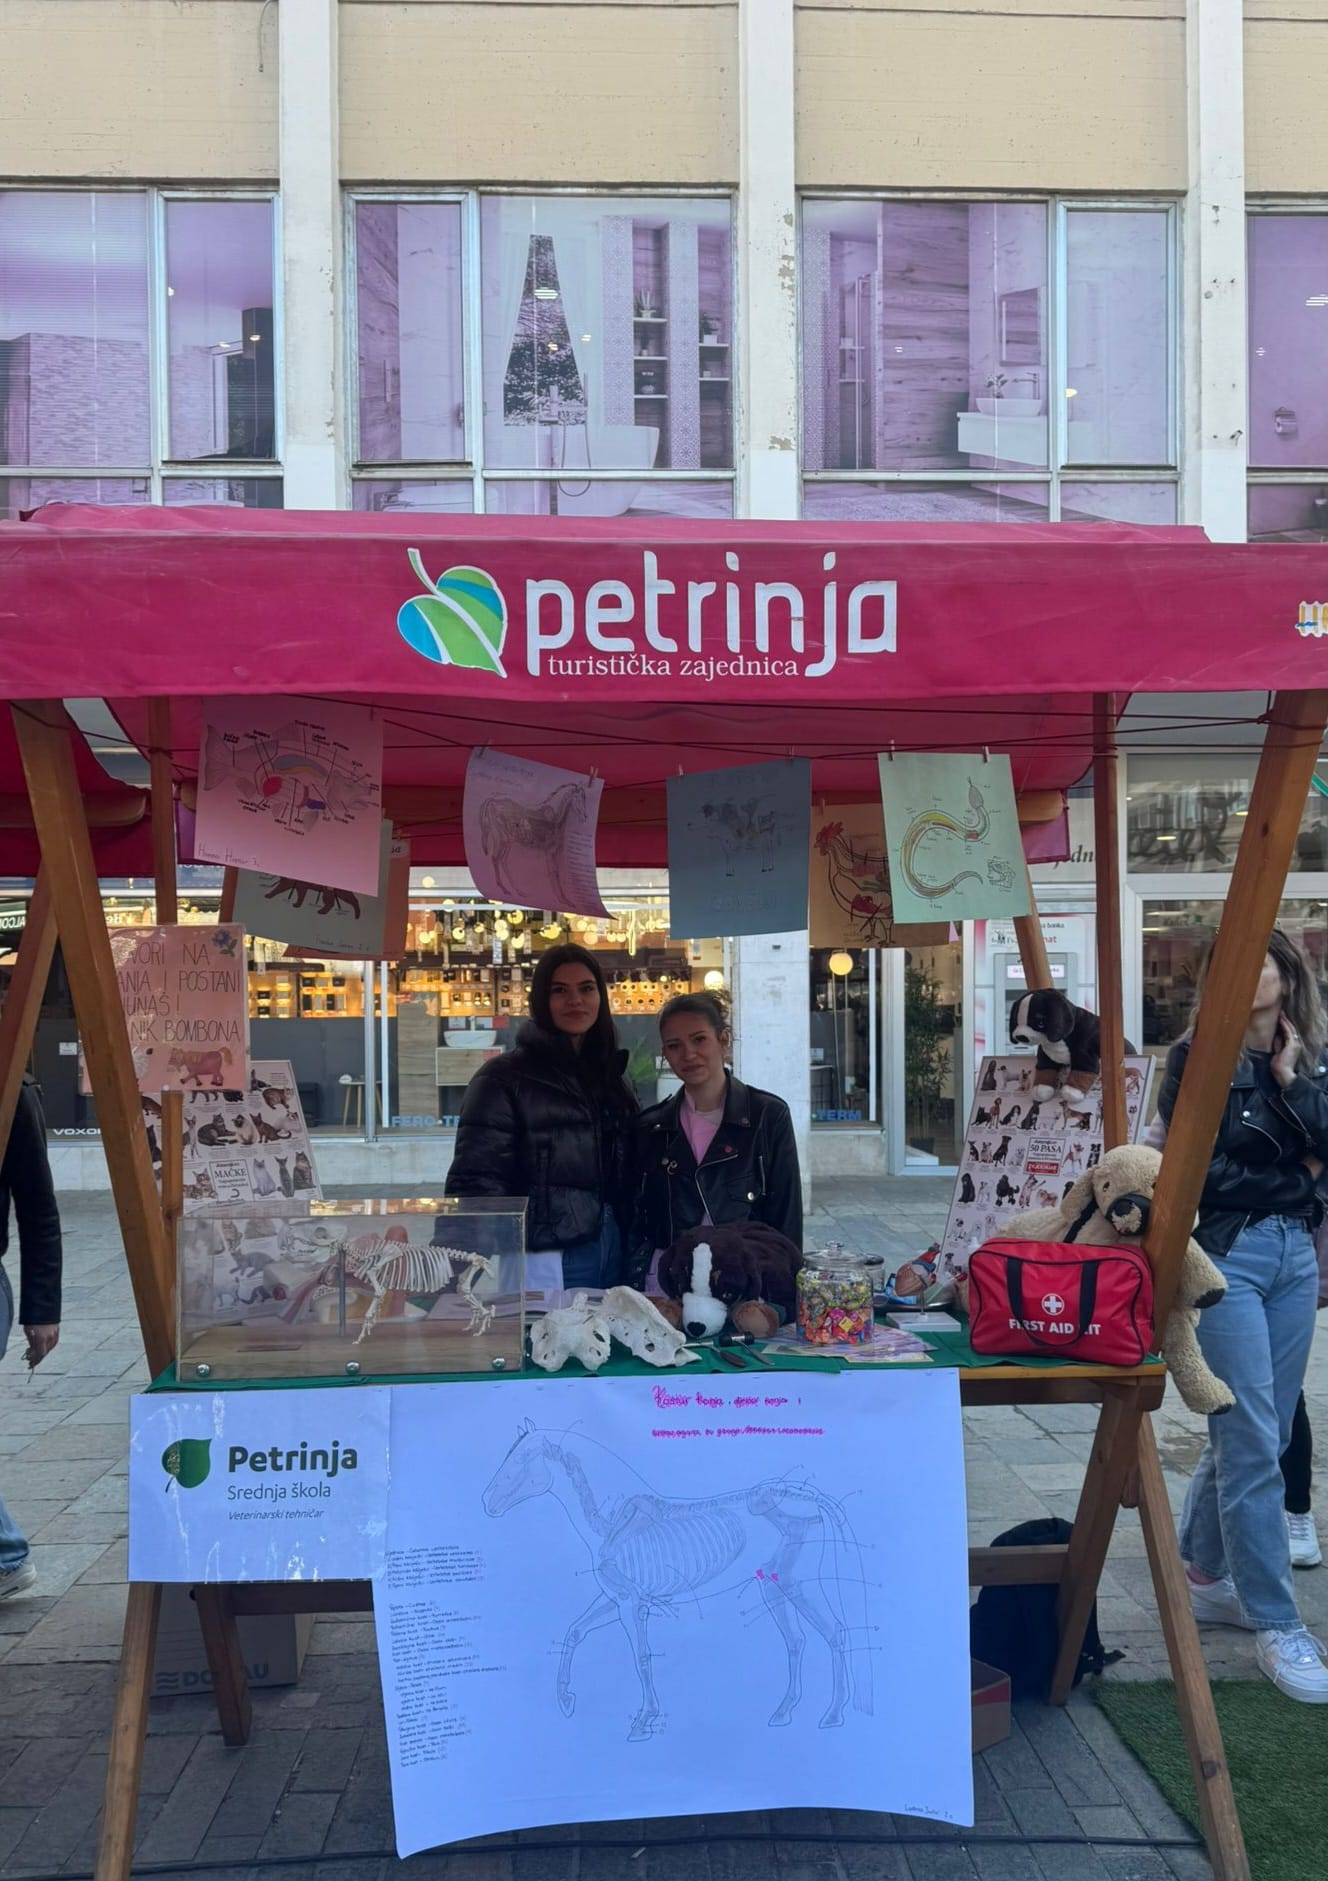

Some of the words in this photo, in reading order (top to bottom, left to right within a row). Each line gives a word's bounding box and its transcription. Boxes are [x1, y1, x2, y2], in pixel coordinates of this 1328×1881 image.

[526, 551, 897, 677] petrinja
[548, 654, 671, 676] turistička
[680, 655, 798, 681] zajednica
[182, 943, 210, 966] NA
[178, 970, 240, 993] POSTANI
[164, 1019, 240, 1043] BOMBONA
[1009, 1319, 1045, 1332] FIRST
[1049, 1322, 1074, 1334] AID
[1084, 1323, 1101, 1335] IT
[228, 1440, 358, 1478] Petrinja
[227, 1483, 287, 1502] Srednja
[291, 1481, 331, 1498] škola
[228, 1509, 284, 1520] Veterinarski
[285, 1508, 325, 1519] tehničar
